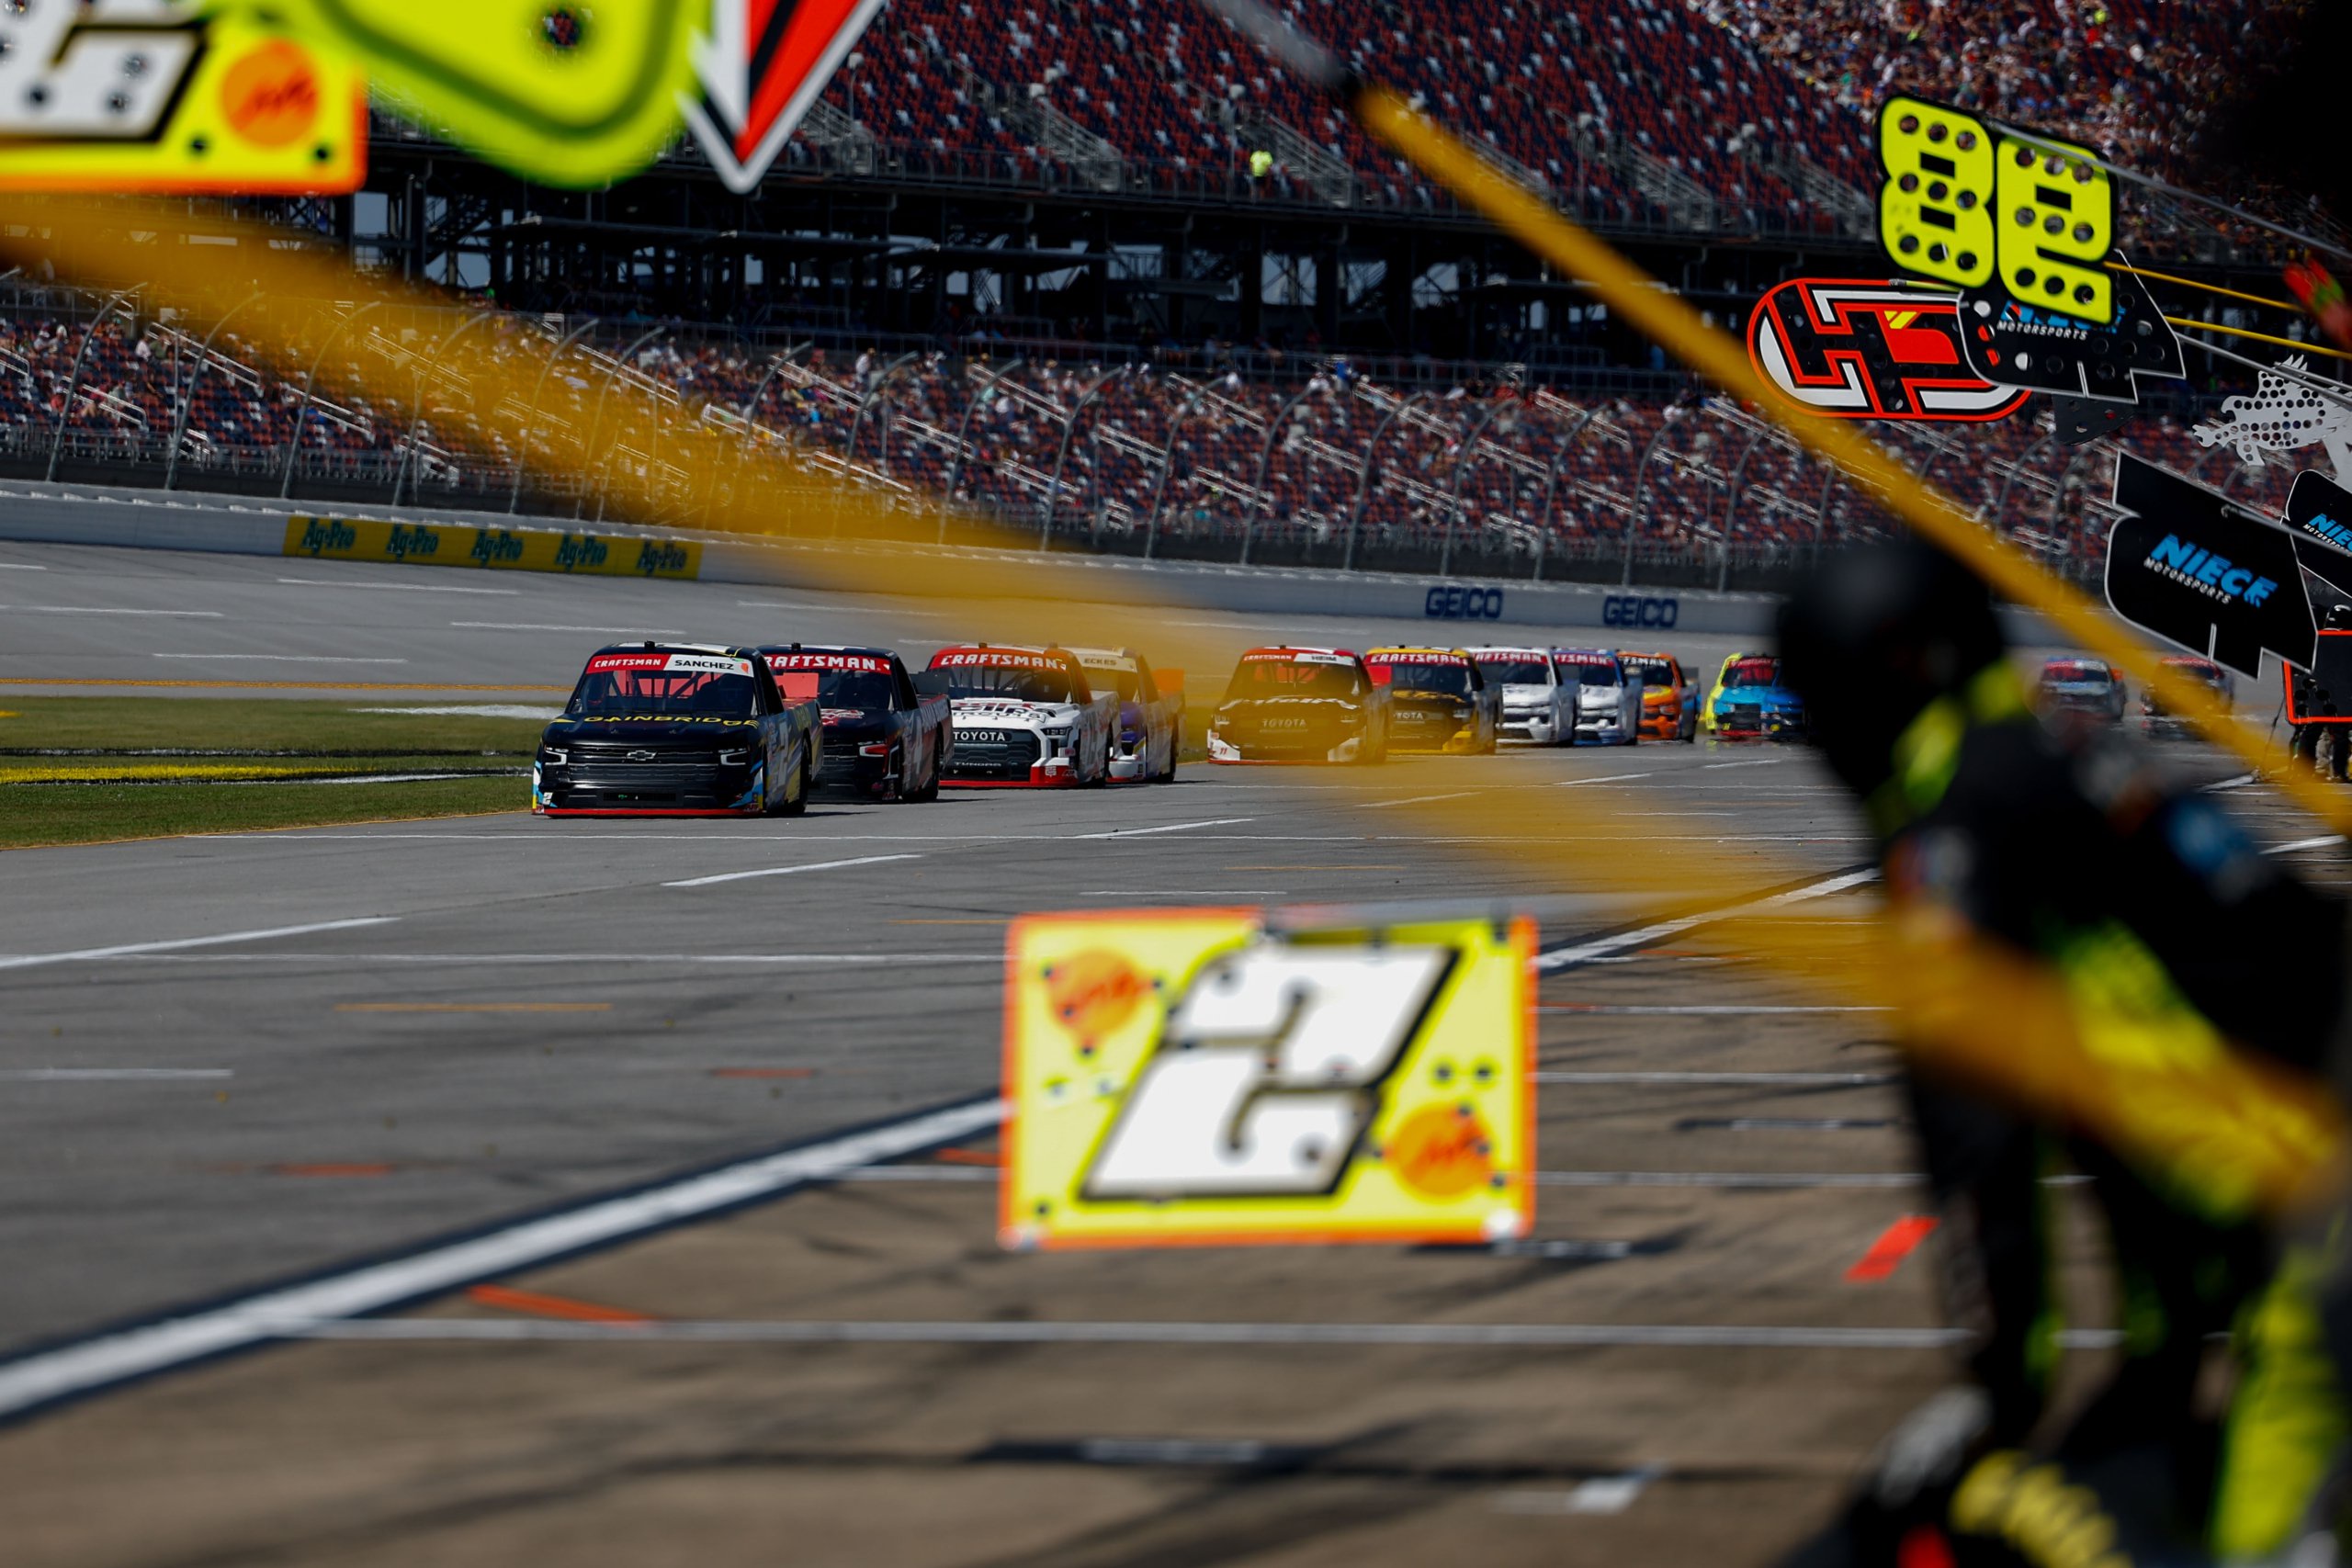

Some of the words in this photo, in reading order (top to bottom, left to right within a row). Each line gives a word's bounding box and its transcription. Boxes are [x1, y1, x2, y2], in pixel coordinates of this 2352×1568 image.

[1996, 321, 2087, 341] MOTORSPORTS
[2302, 524, 2349, 553] MOTORSPO
[2308, 513, 2352, 553] NIE
[2150, 533, 2278, 608] NIECE
[2143, 556, 2232, 605] MOTORSPORTS
[1425, 586, 1503, 620] GEICO
[1603, 596, 1679, 628] GEICO
[594, 658, 662, 669] CRAFTSMAN
[674, 659, 734, 671] SANCHEZ
[763, 655, 876, 671] RAFTSMAN
[940, 653, 1058, 671] CRAFTSMAN
[1083, 658, 1117, 667] ECKES
[1370, 653, 1461, 664] CRAFTSMAN
[1474, 652, 1542, 663] AFTSMAN
[583, 715, 760, 729] GAINBRIDGE
[1261, 717, 1307, 728] TOYOTA
[1396, 712, 1424, 721] YOTA
[953, 731, 1006, 742] TOYOTA
[542, 792, 554, 806] 2
